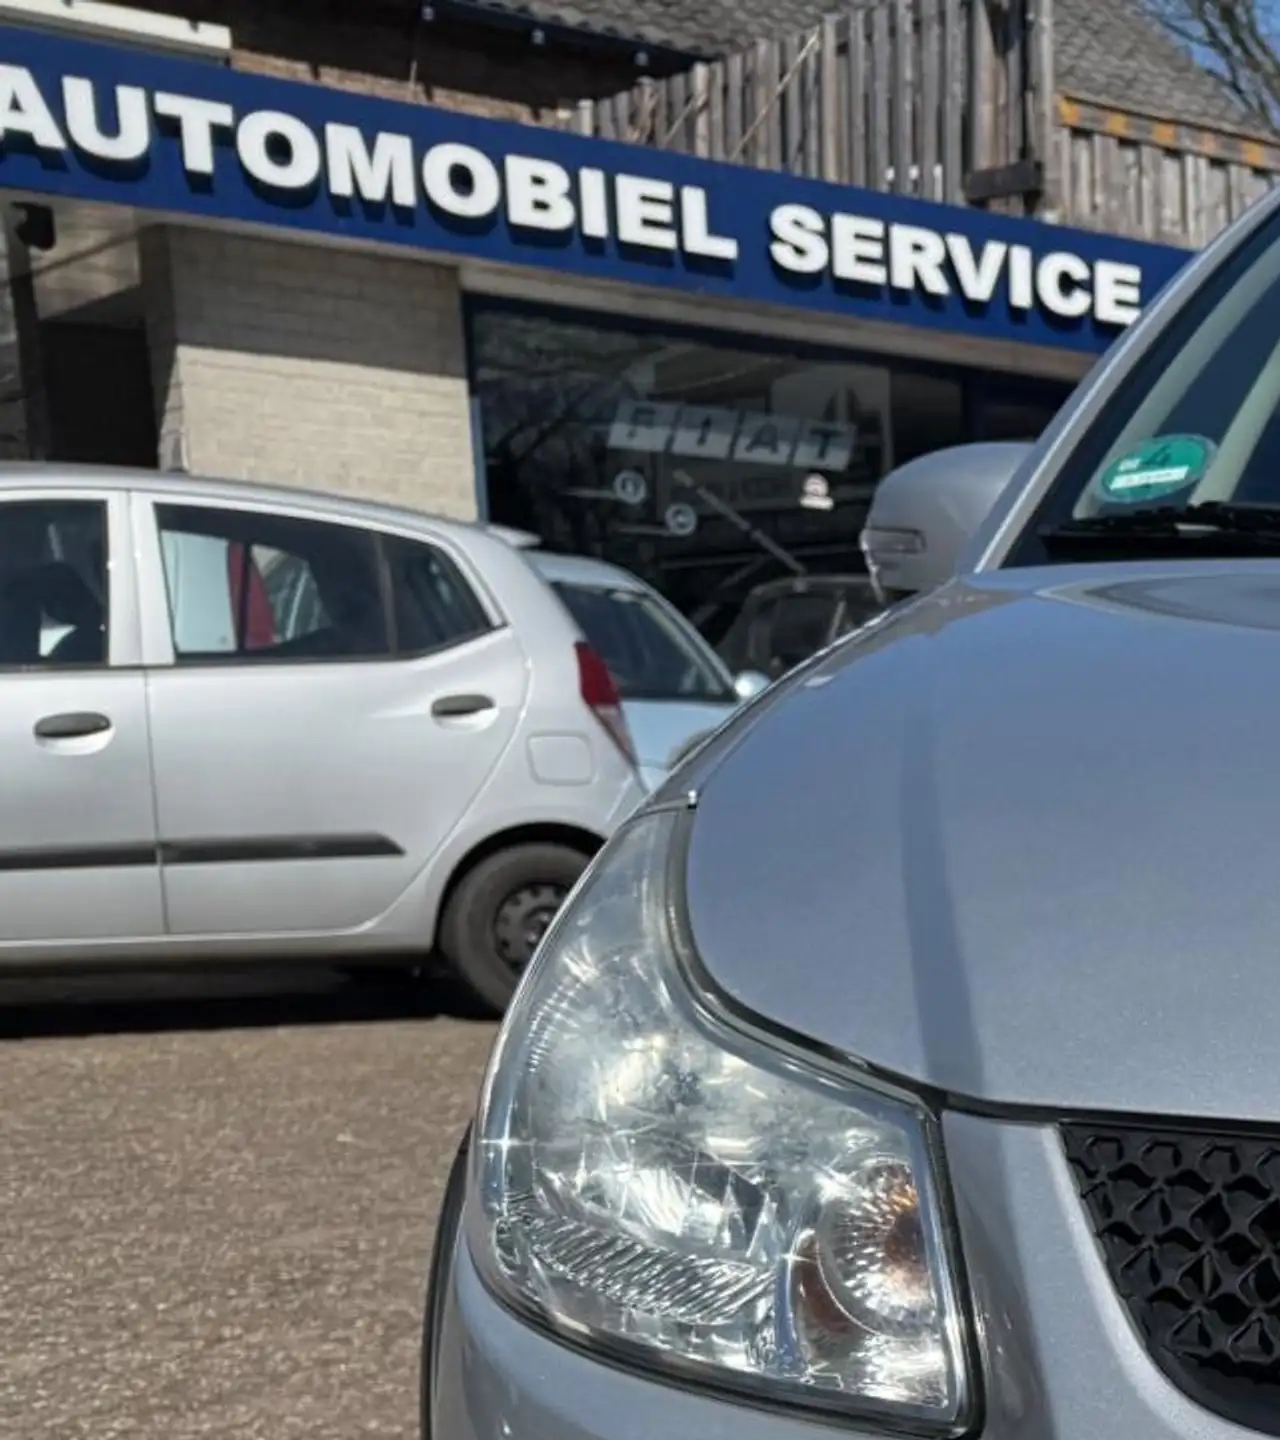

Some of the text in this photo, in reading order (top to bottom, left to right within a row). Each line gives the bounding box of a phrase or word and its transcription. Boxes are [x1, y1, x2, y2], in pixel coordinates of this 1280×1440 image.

[0, 65, 1142, 326] AUTOMOBIEL SERVICE
[626, 405, 844, 460] FIAT
